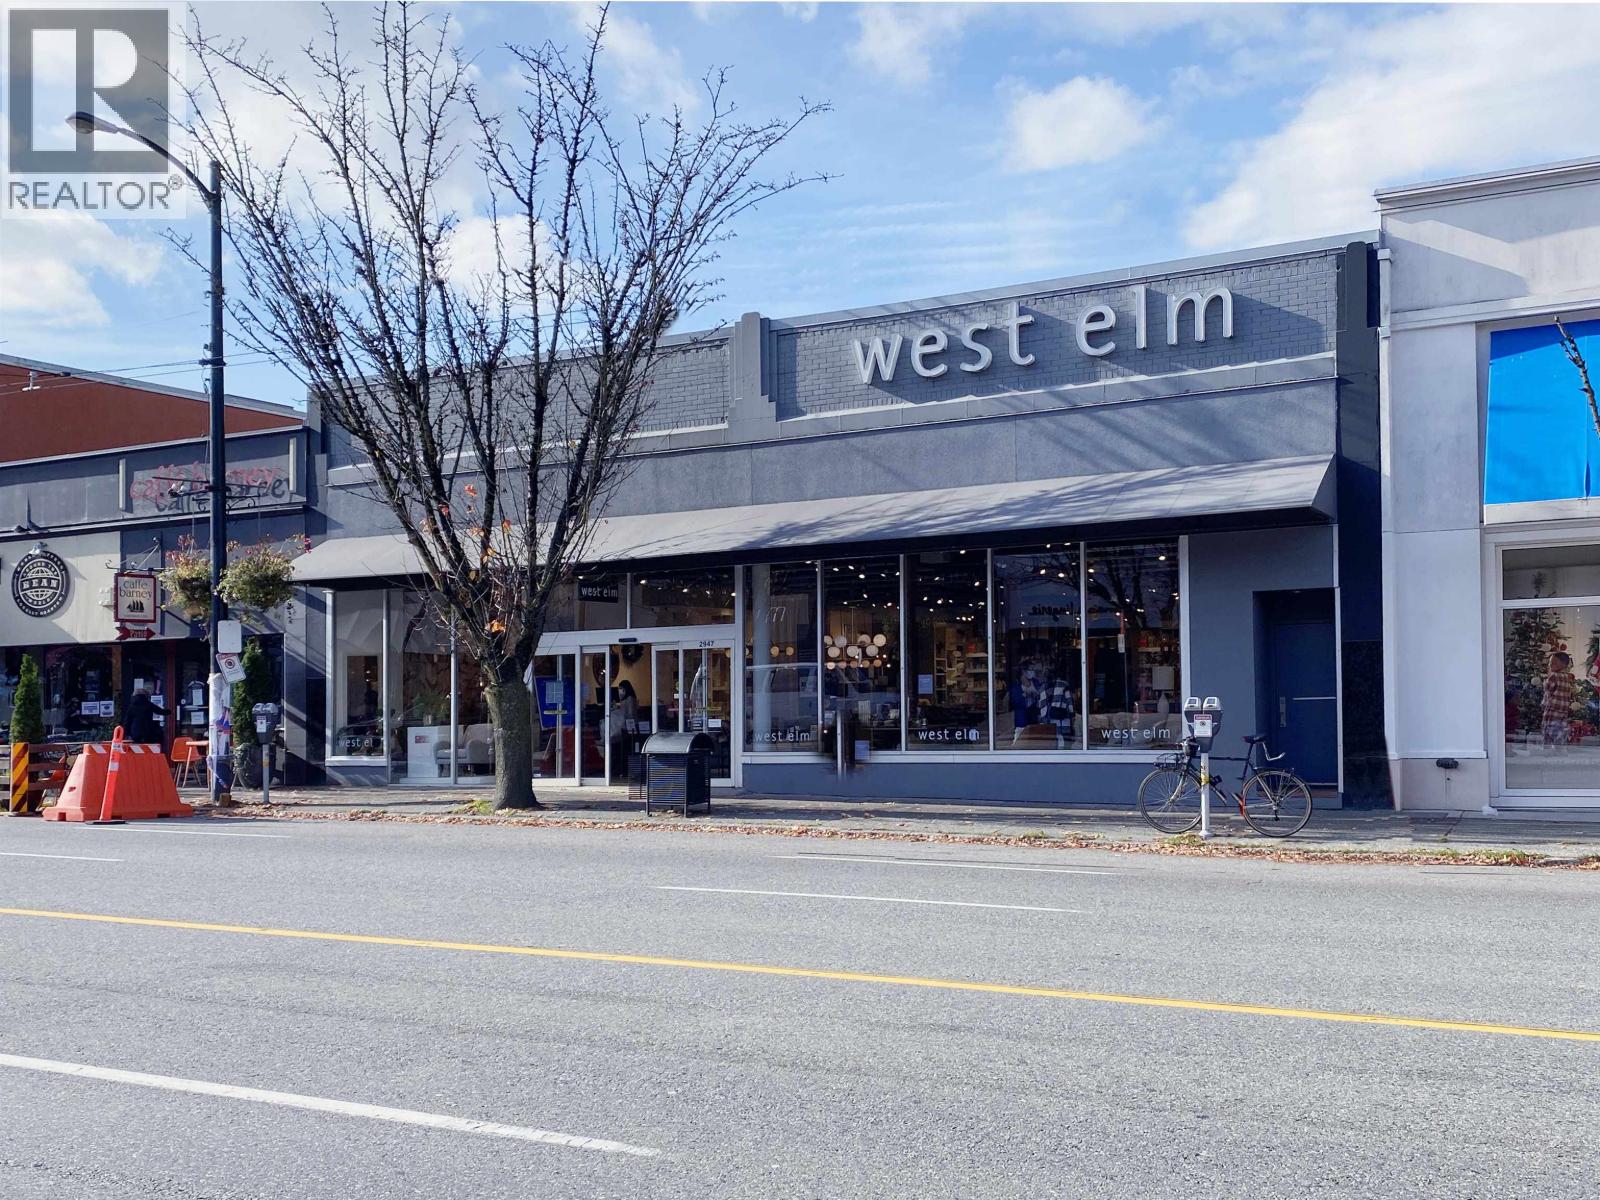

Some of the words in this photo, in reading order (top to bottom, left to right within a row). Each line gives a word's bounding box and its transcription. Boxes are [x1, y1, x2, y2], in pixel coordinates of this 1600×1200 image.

[852, 301, 1035, 385] west
[1076, 285, 1233, 357] elm
[22, 579, 59, 589] BEAN
[119, 586, 152, 600] barney
[581, 585, 601, 597] west
[603, 588, 618, 598] elm
[699, 640, 715, 648] 2947
[755, 730, 782, 742] west
[788, 729, 810, 742] elm
[918, 728, 949, 740] west
[1101, 727, 1138, 739] west
[1143, 726, 1171, 739] elm
[338, 737, 361, 748] west
